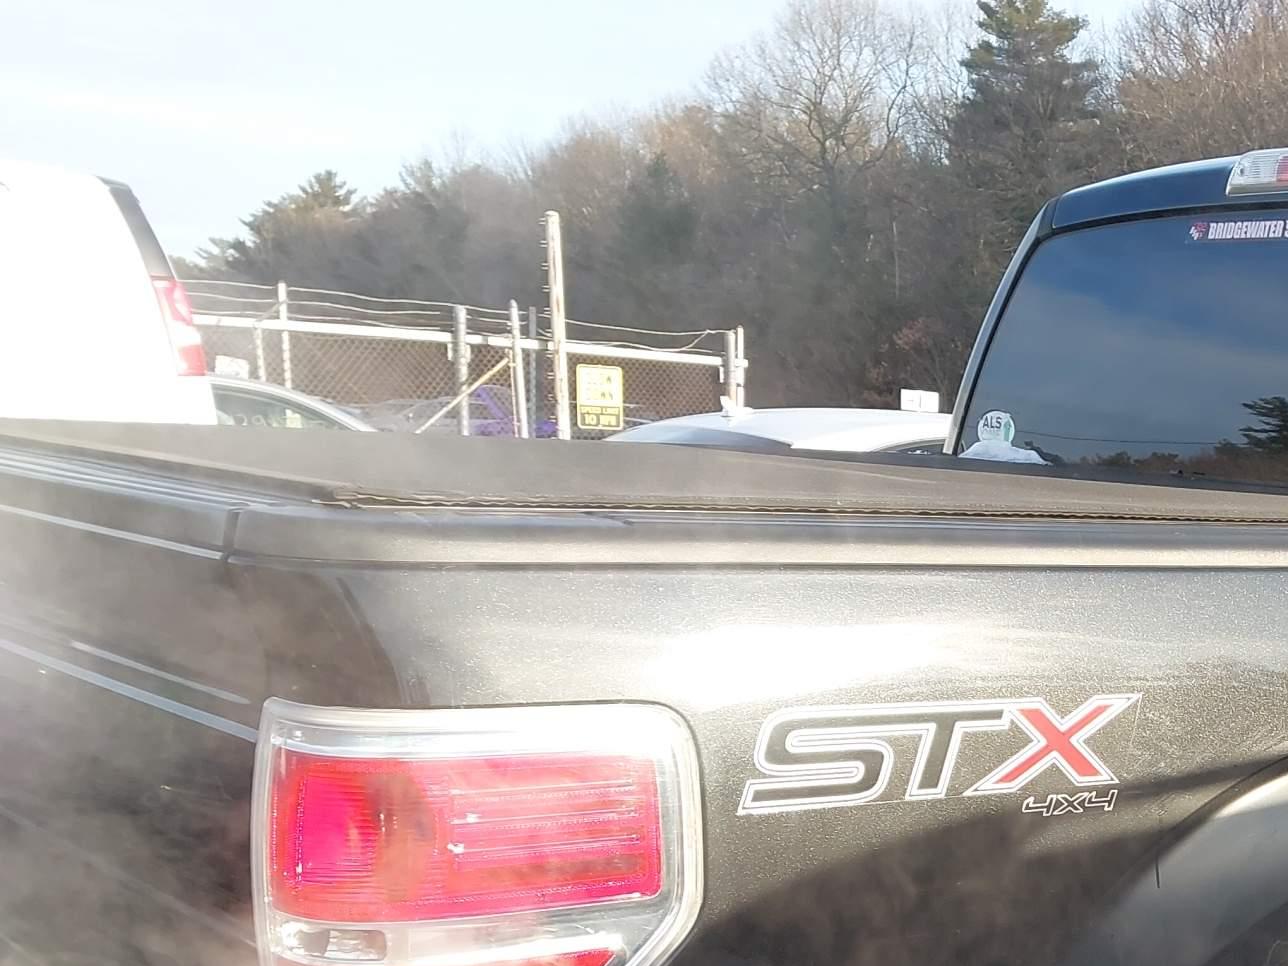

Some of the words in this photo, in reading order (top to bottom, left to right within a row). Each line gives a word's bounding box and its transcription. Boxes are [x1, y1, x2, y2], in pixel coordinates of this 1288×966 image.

[1207, 220, 1284, 240] BRIDGEWATER
[584, 413, 597, 425] 10
[982, 416, 1002, 429] ALS
[736, 692, 1143, 815] STX
